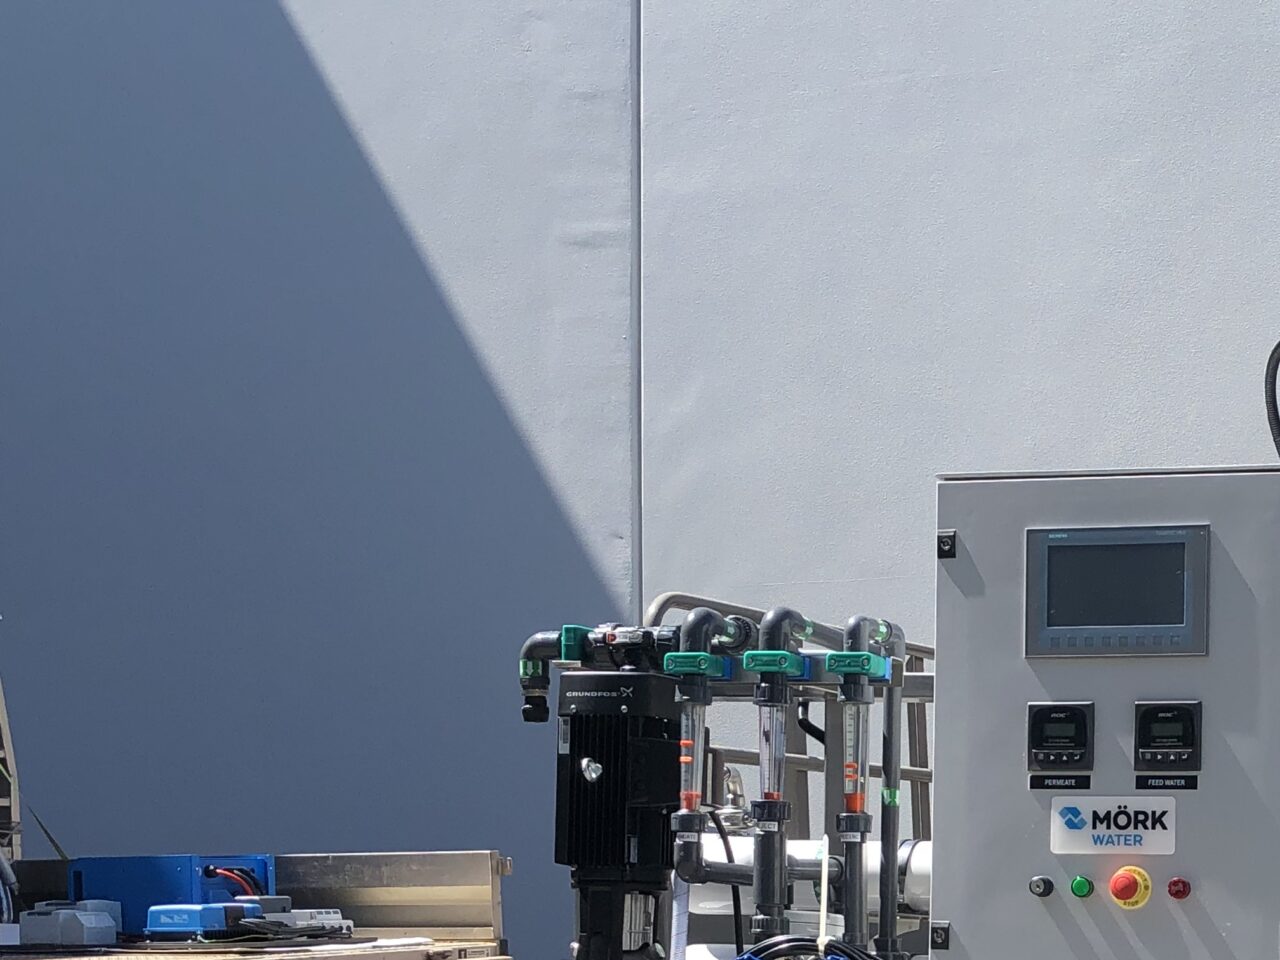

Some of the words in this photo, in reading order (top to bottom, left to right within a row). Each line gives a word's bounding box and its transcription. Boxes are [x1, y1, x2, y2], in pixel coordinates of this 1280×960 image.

[1044, 778, 1076, 786] PERMEATE
[1148, 778, 1163, 786] FEED
[1165, 778, 1185, 786] WATER
[1092, 805, 1168, 830] MÖRK
[1092, 834, 1143, 846] WATER
